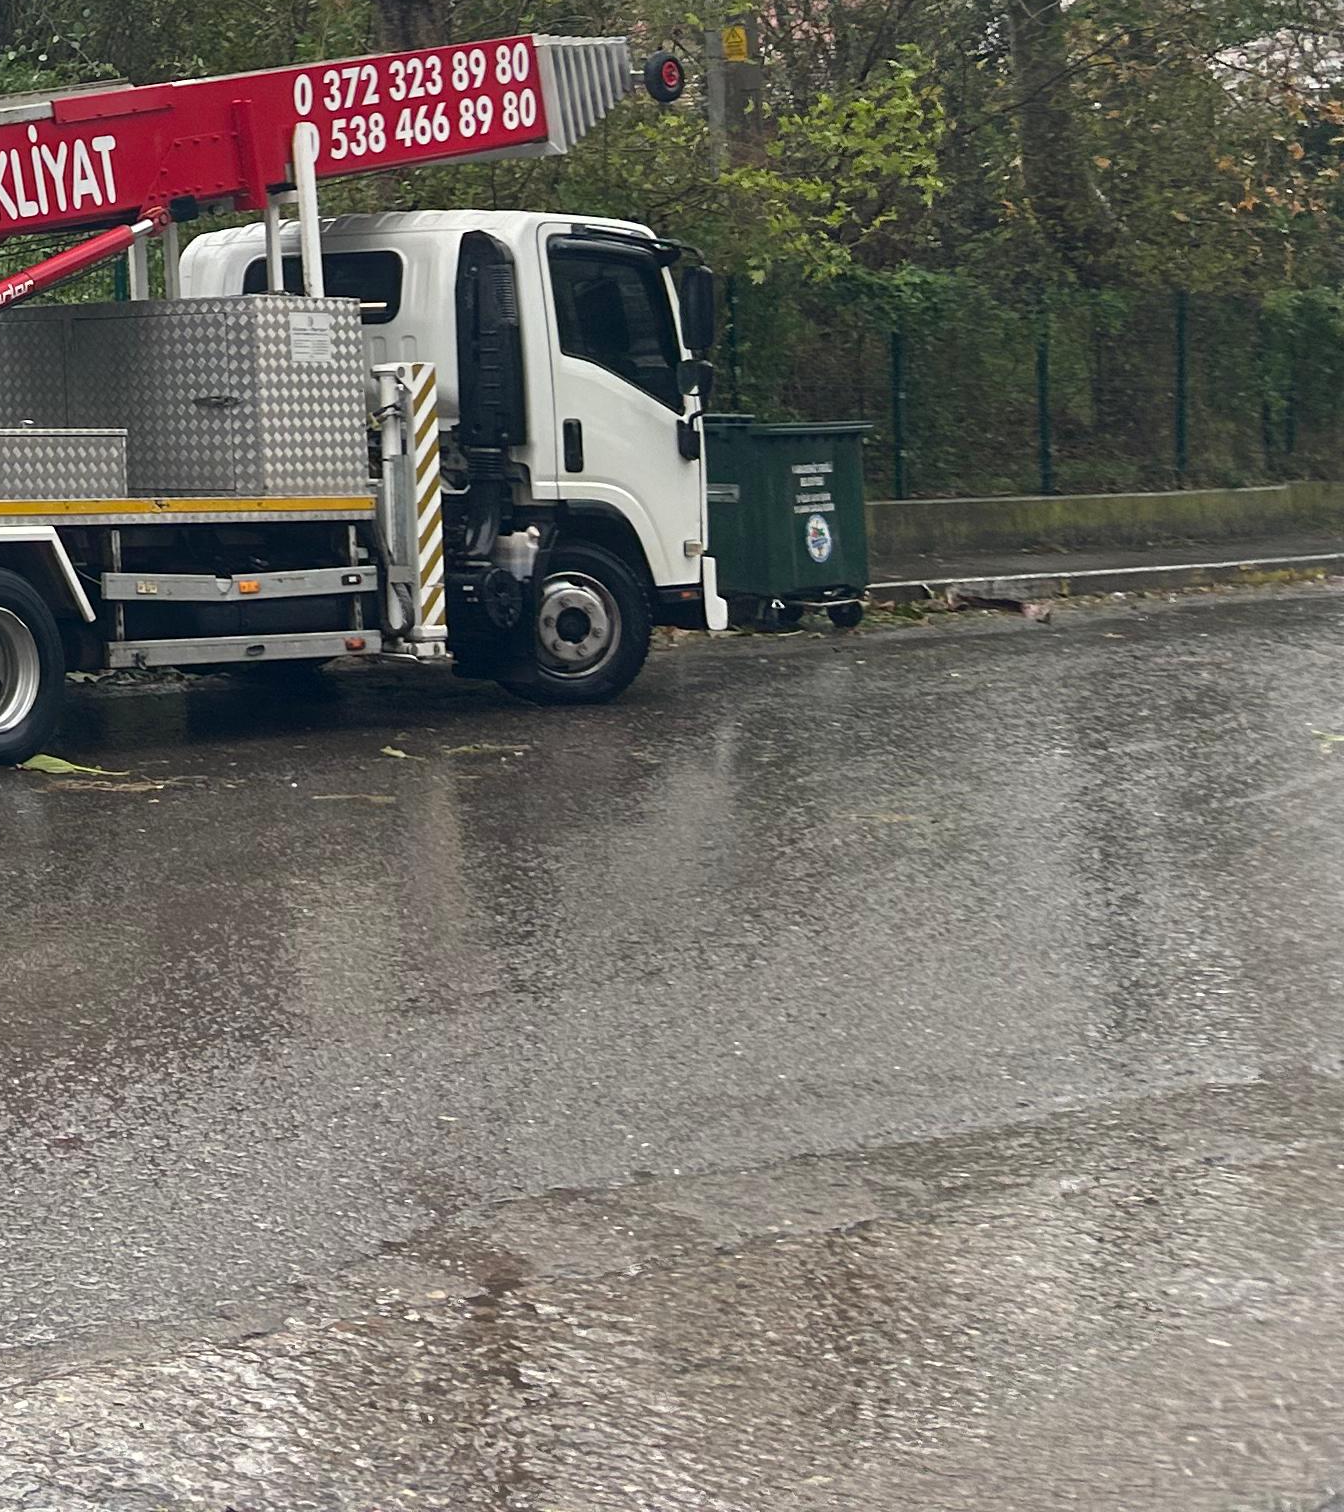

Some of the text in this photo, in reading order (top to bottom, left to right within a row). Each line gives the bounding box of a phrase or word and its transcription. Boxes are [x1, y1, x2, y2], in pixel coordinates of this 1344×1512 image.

[294, 42, 529, 116] 0 372 323 89 80
[330, 112, 387, 160] 538
[395, 101, 451, 148] 466
[459, 95, 494, 138] 89
[502, 88, 537, 131] 80
